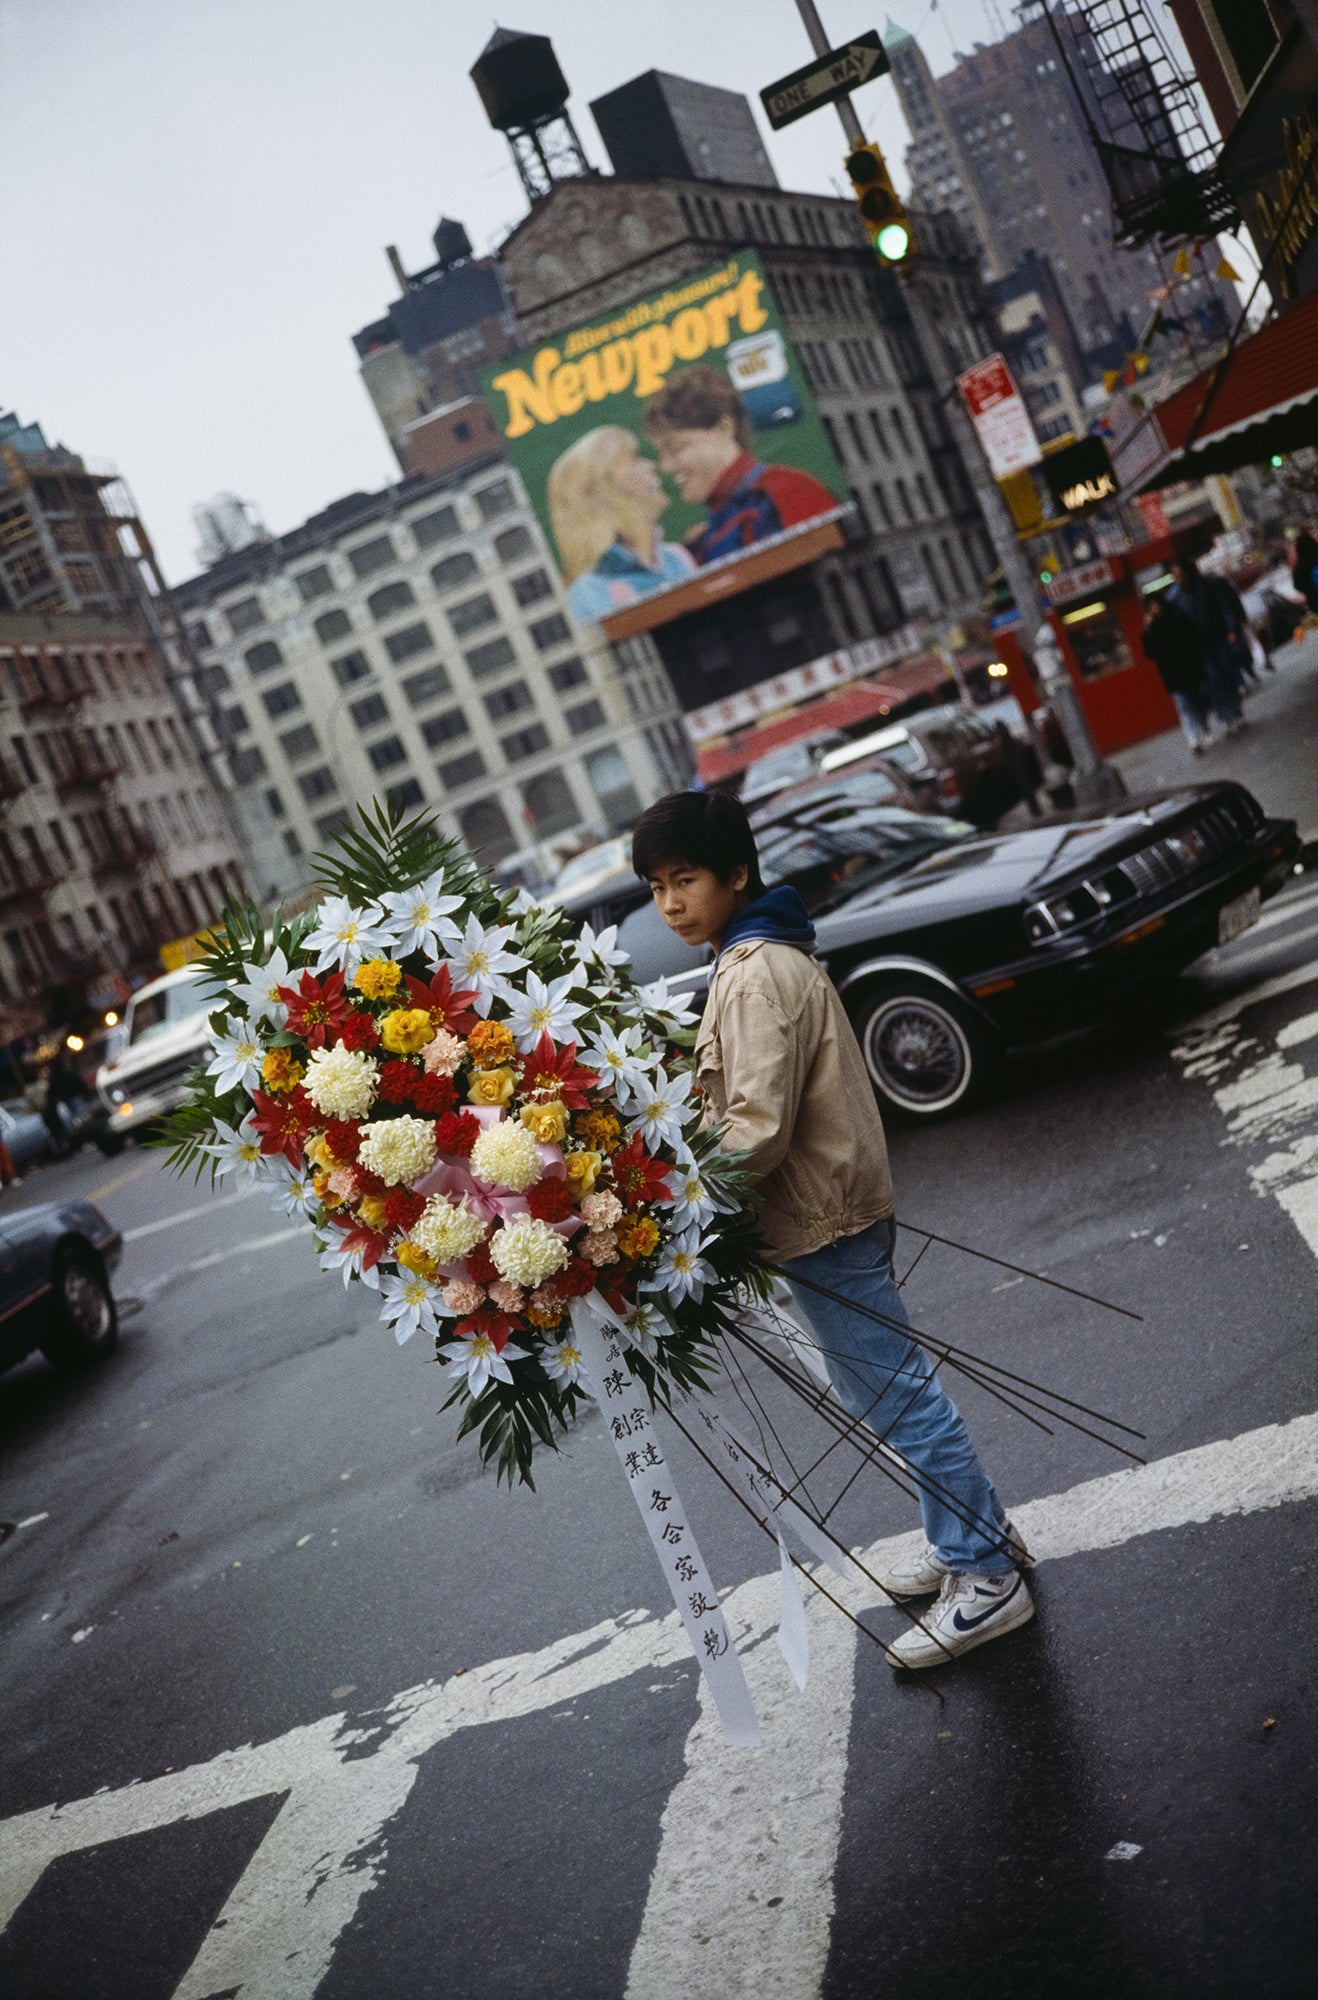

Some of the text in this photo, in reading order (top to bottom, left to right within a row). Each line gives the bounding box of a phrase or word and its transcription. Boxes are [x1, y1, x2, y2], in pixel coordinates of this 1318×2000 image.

[772, 51, 865, 113] ONE WAY
[492, 270, 769, 438] Newport
[1060, 472, 1116, 510] WALK
[986, 1577, 1006, 1587] NIKE
